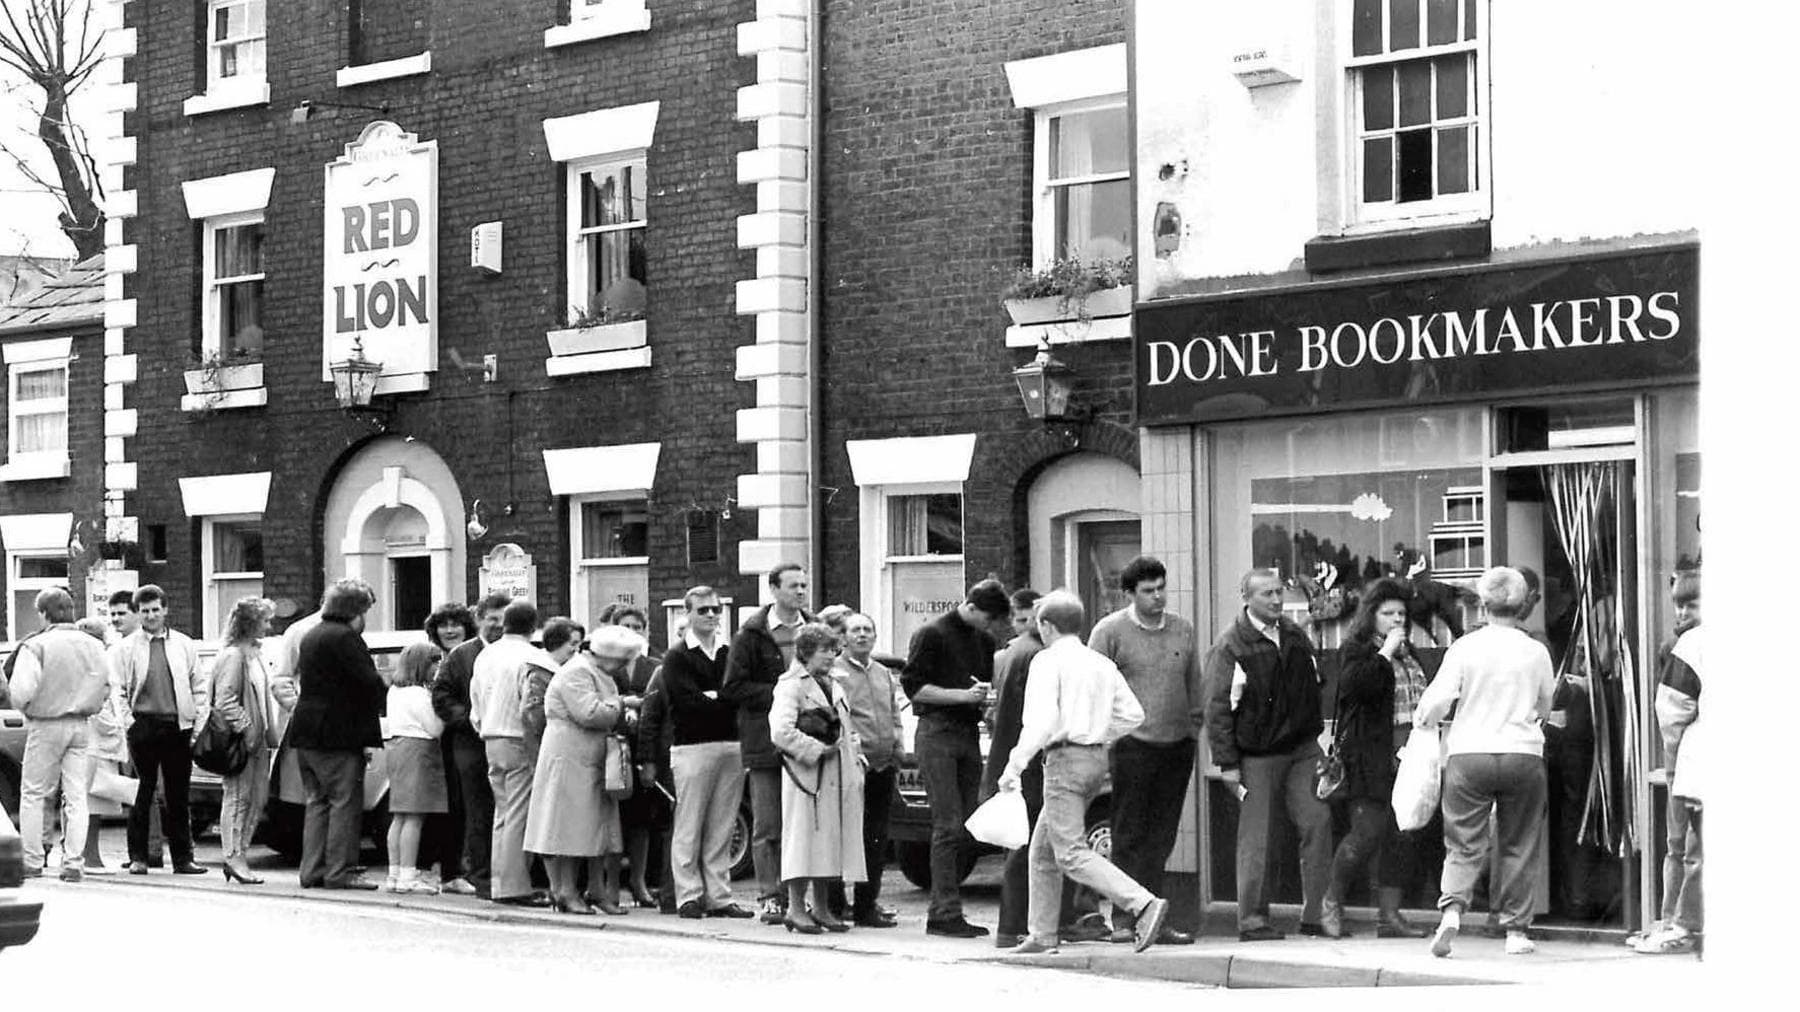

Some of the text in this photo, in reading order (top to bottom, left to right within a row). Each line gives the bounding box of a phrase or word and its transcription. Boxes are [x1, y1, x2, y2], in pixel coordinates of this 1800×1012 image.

[342, 198, 420, 254] RED
[333, 275, 429, 333] LION
[1147, 291, 1680, 386] DONE BOOKMAKERS
[617, 593, 635, 605] THE
[903, 600, 963, 613] WILDERSPOO
